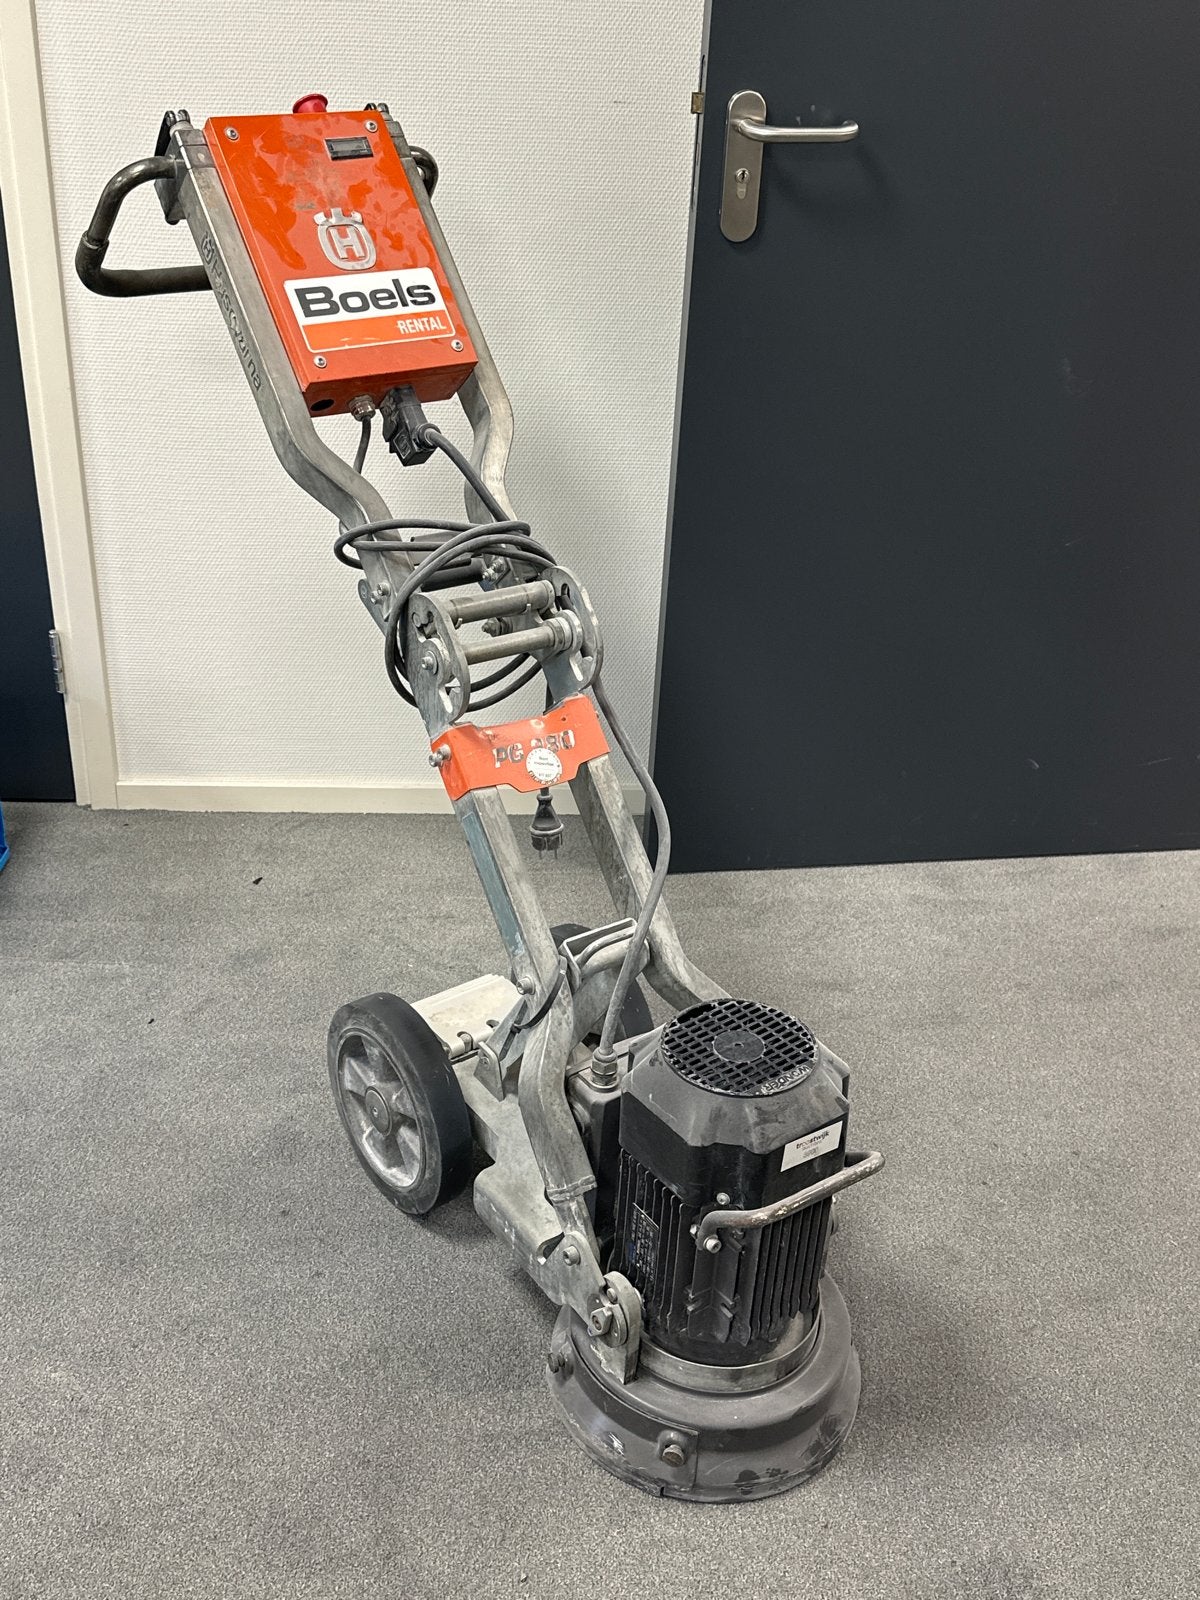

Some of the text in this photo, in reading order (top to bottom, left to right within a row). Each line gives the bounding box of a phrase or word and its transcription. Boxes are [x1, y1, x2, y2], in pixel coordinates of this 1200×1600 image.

[294, 278, 436, 318] Boels
[398, 316, 447, 335] RENTAL
[492, 743, 524, 768] PG
[763, 1065, 811, 1091] WONDER
